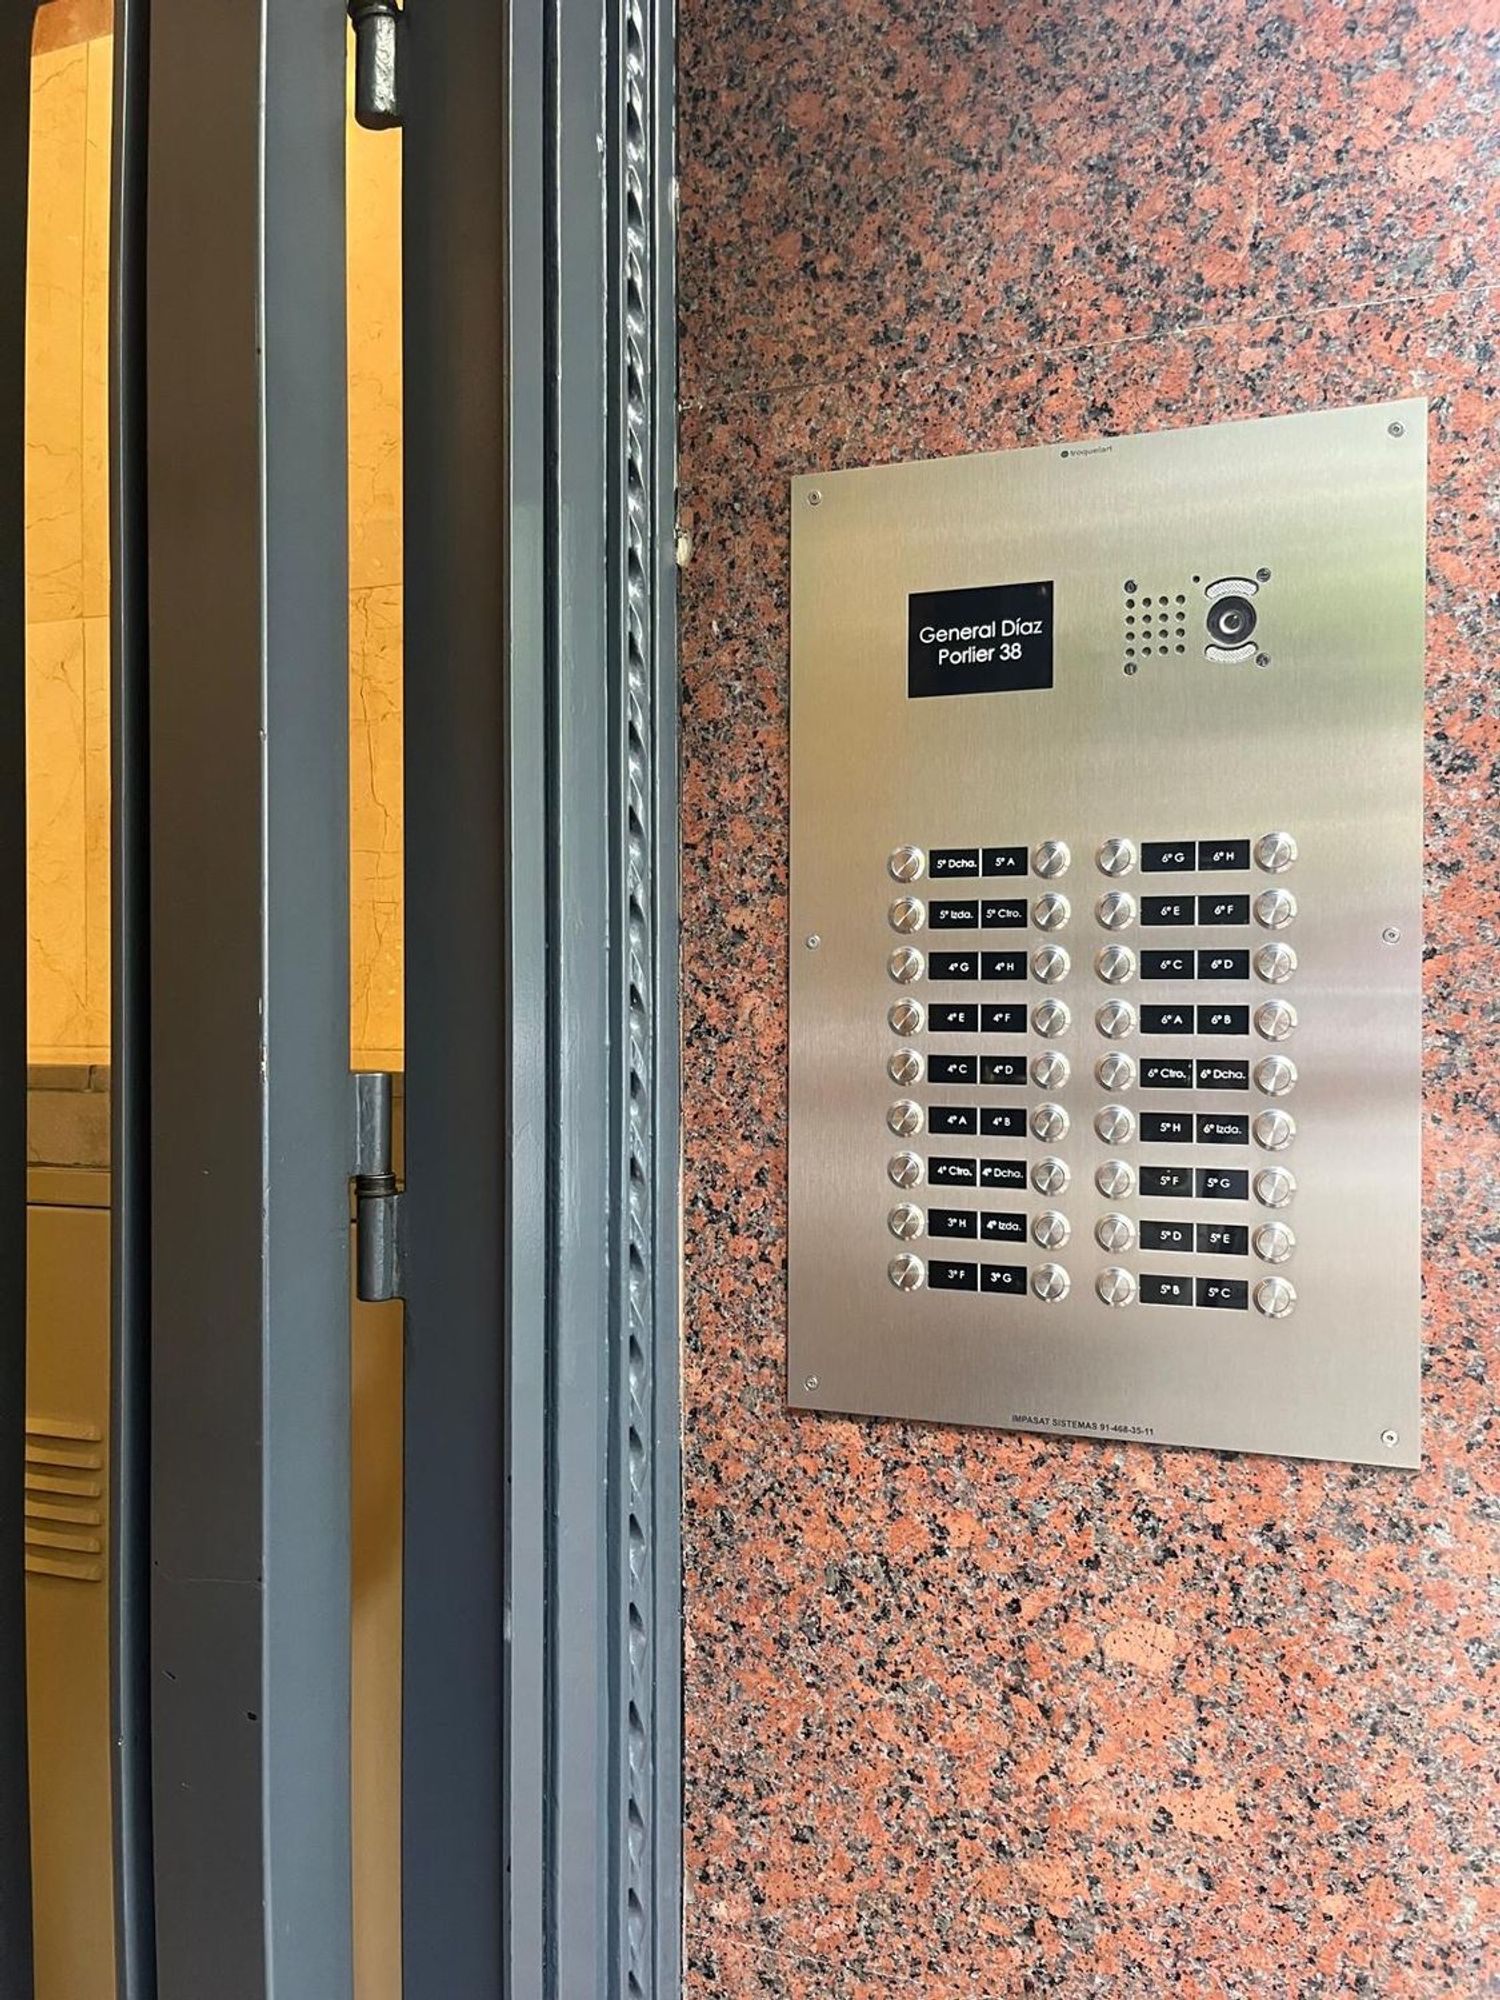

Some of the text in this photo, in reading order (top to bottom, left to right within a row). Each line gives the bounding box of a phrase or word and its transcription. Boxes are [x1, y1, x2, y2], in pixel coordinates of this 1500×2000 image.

[920, 618, 1042, 643] General Díaz
[939, 643, 1022, 665] Porlier 38
[1175, 853, 1185, 862] G
[1226, 852, 1235, 860] H
[1174, 906, 1180, 915] E
[1228, 905, 1234, 914] F
[960, 963, 970, 971] G
[1173, 960, 1183, 969] C
[1224, 959, 1234, 969] D
[959, 1013, 965, 1022] E
[1005, 1014, 1011, 1022] F
[1174, 1015, 1183, 1024] A
[1224, 1015, 1232, 1024] B
[959, 1064, 968, 1073] C
[1005, 1065, 1014, 1074] D
[959, 1116, 967, 1124] A
[1005, 1117, 1011, 1126] B
[1173, 1123, 1182, 1132] H
[1173, 1177, 1179, 1185] F
[1220, 1179, 1231, 1188] G
[959, 1219, 967, 1227] H
[1173, 1231, 1183, 1241] D
[1223, 1234, 1230, 1243] E
[960, 1270, 965, 1278] F
[1003, 1274, 1013, 1282] G
[1173, 1285, 1181, 1295] B
[1221, 1288, 1231, 1298] C
[1012, 1414, 1050, 1425] IMPASAT
[1052, 1419, 1097, 1430] SISTEMAS
